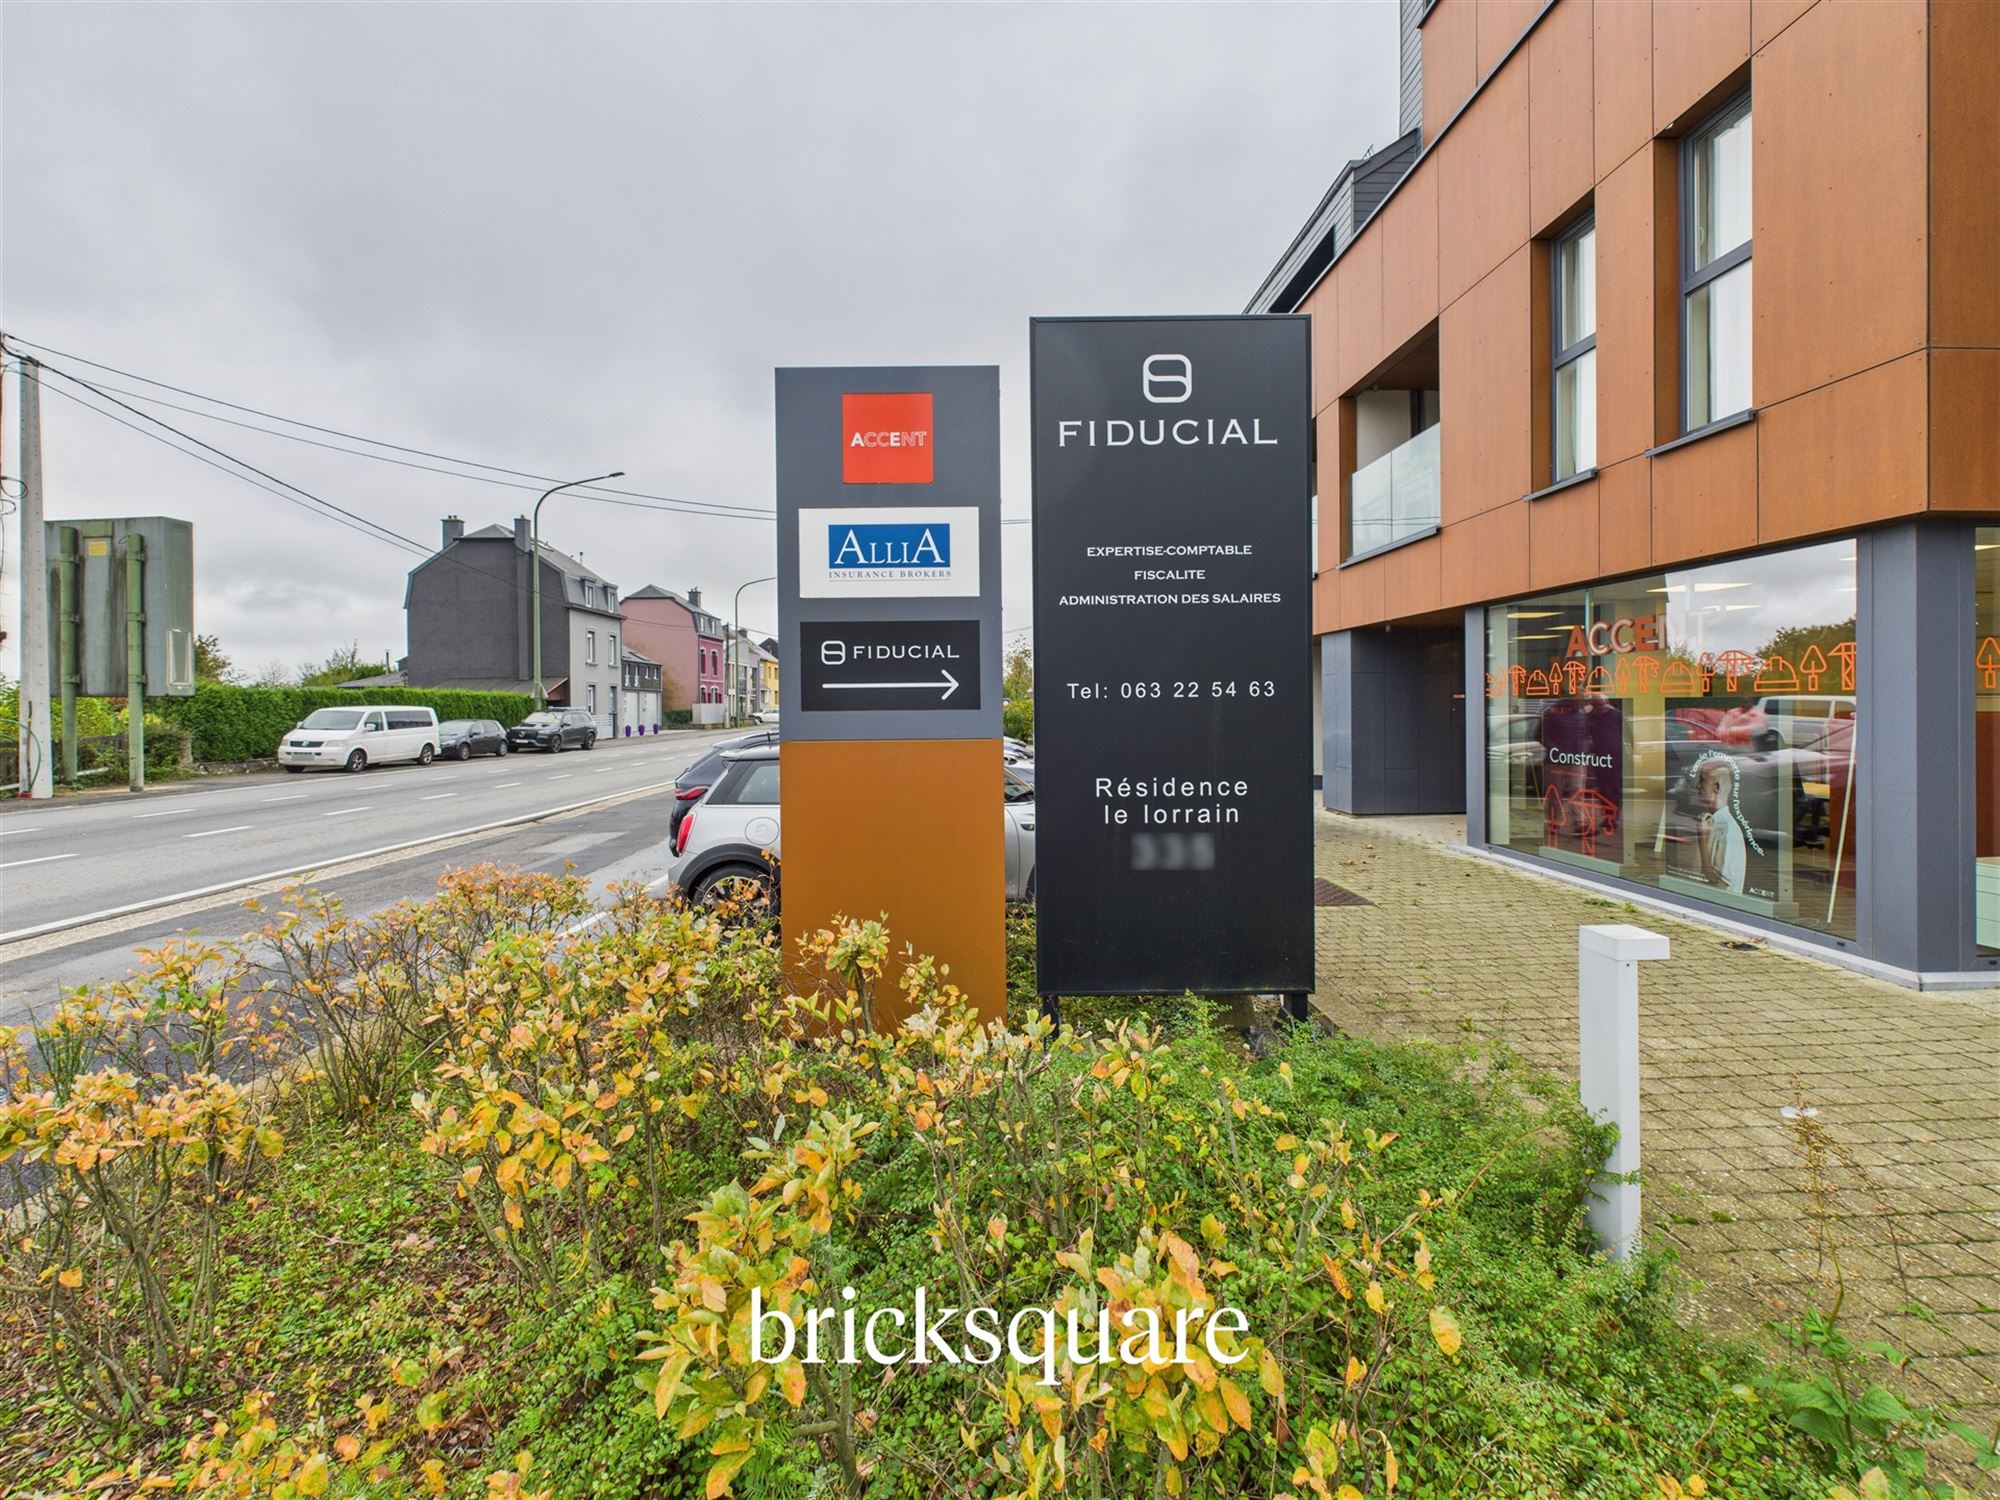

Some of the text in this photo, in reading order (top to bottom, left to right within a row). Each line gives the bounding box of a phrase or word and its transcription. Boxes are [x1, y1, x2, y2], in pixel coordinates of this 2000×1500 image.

[850, 430, 927, 448] ACCENT
[1058, 418, 1278, 447] FIDUCIAL
[1086, 545, 1253, 557] EXPERTISE-COMPTABLE
[828, 568, 952, 579] INSURANCE BROKERS
[1133, 569, 1206, 580] FISCALITE
[1058, 593, 1281, 606] ADMINISTRATION DES SALAIRES
[853, 645, 960, 660] FIDUCIAL
[1067, 681, 1275, 699] Tel: 063 22 54 63
[1549, 747, 1613, 768] Construct
[1095, 778, 1249, 797] Résidence
[1104, 804, 1239, 824] le lorrain
